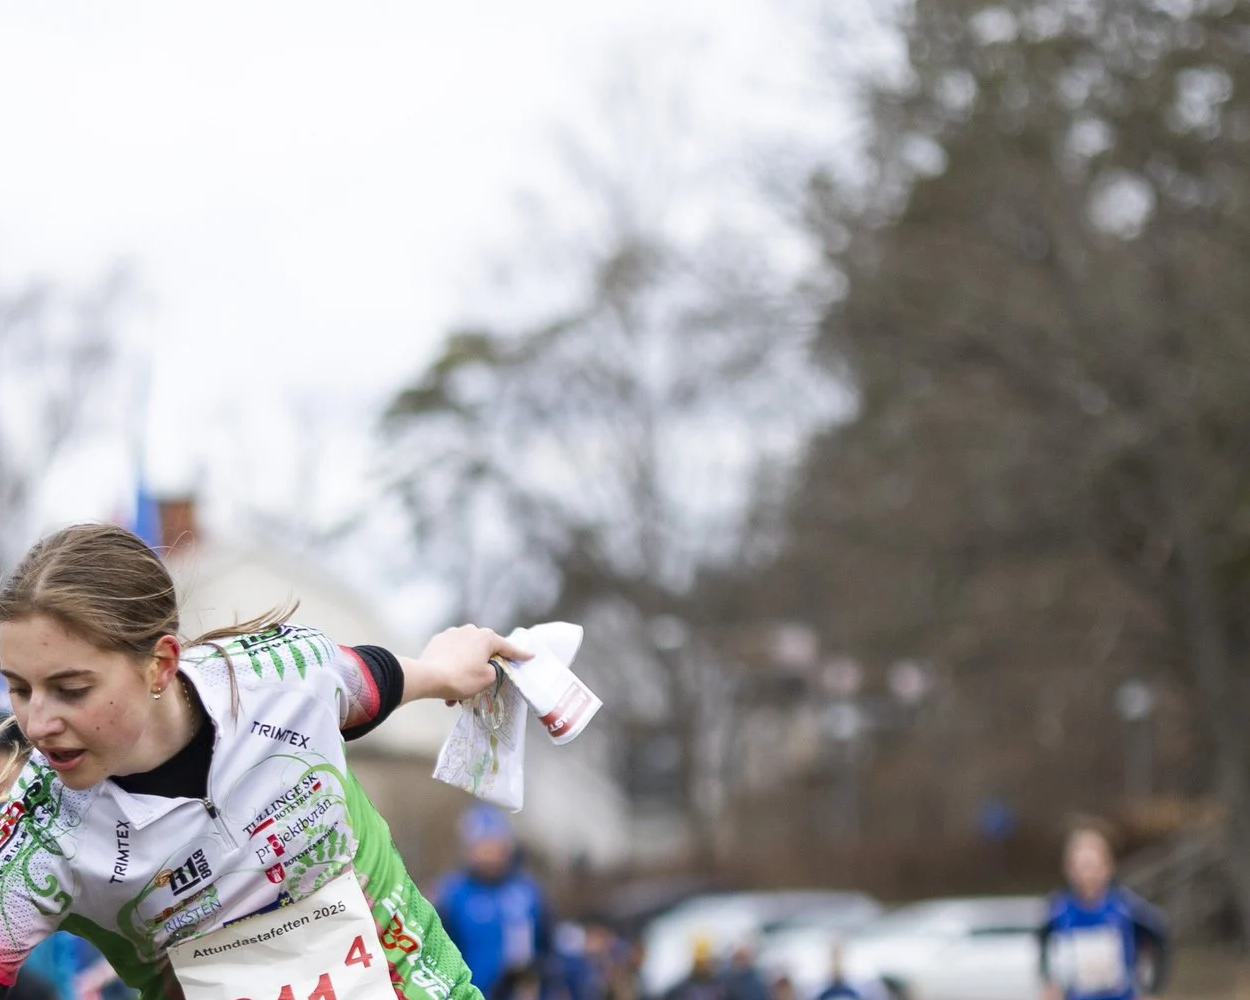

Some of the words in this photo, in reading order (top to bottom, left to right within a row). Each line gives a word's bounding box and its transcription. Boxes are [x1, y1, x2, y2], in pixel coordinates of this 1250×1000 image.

[250, 721, 311, 749] TRIMTEX
[301, 772, 319, 789] SK
[109, 819, 131, 885] TRIMTEX
[164, 899, 222, 934] RIKSTEN
[193, 915, 310, 959] Attundastafetten
[313, 901, 346, 922] 2025
[344, 935, 373, 968] 4
